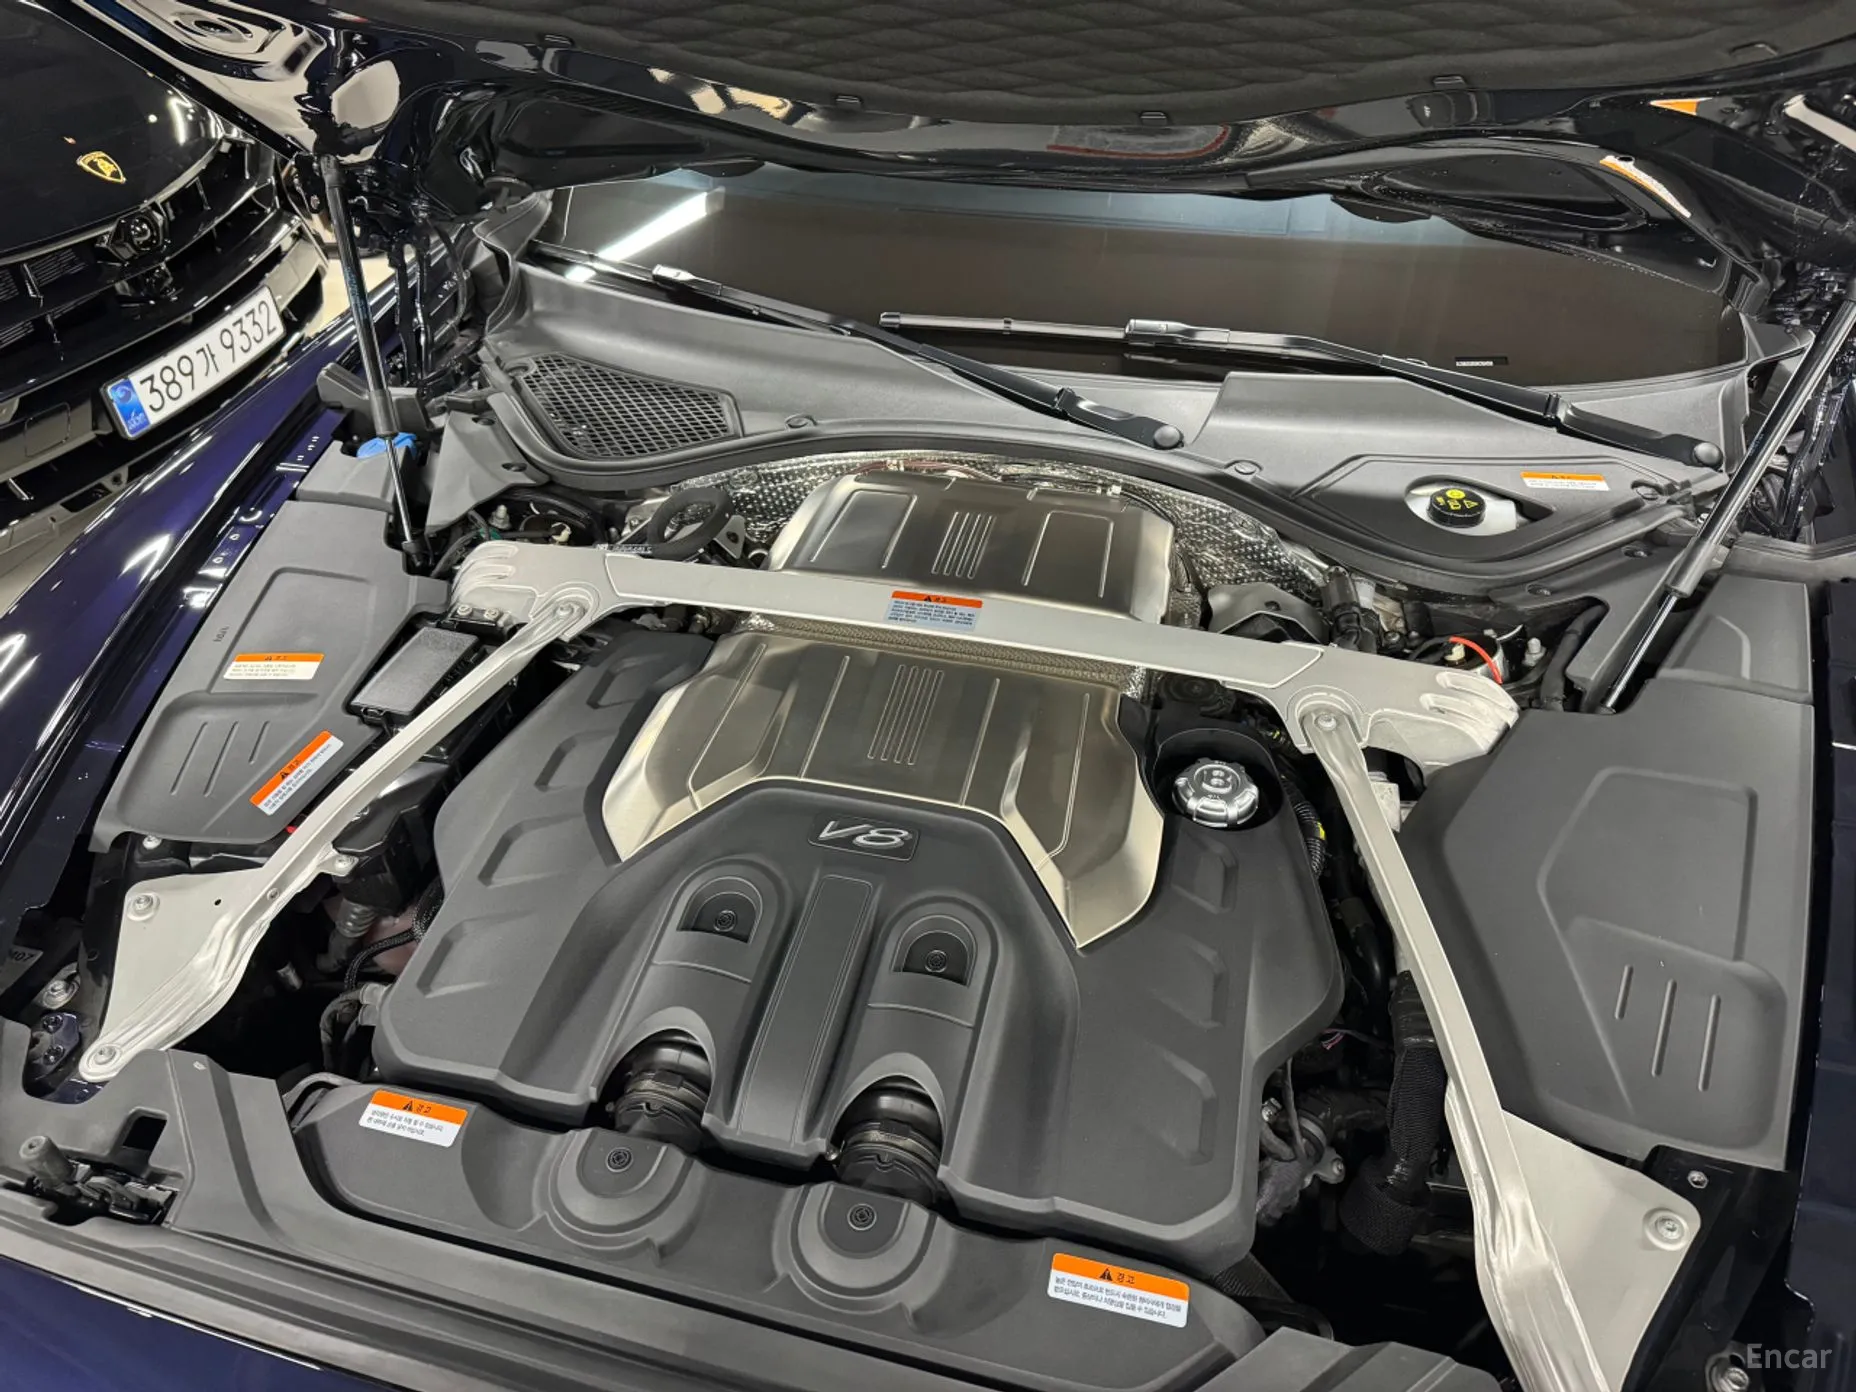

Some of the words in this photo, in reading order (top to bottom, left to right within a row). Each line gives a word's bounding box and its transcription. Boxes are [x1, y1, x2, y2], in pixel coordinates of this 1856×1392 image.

[140, 343, 219, 412] 389가
[220, 300, 277, 363] 9332
[817, 820, 914, 850] V8
